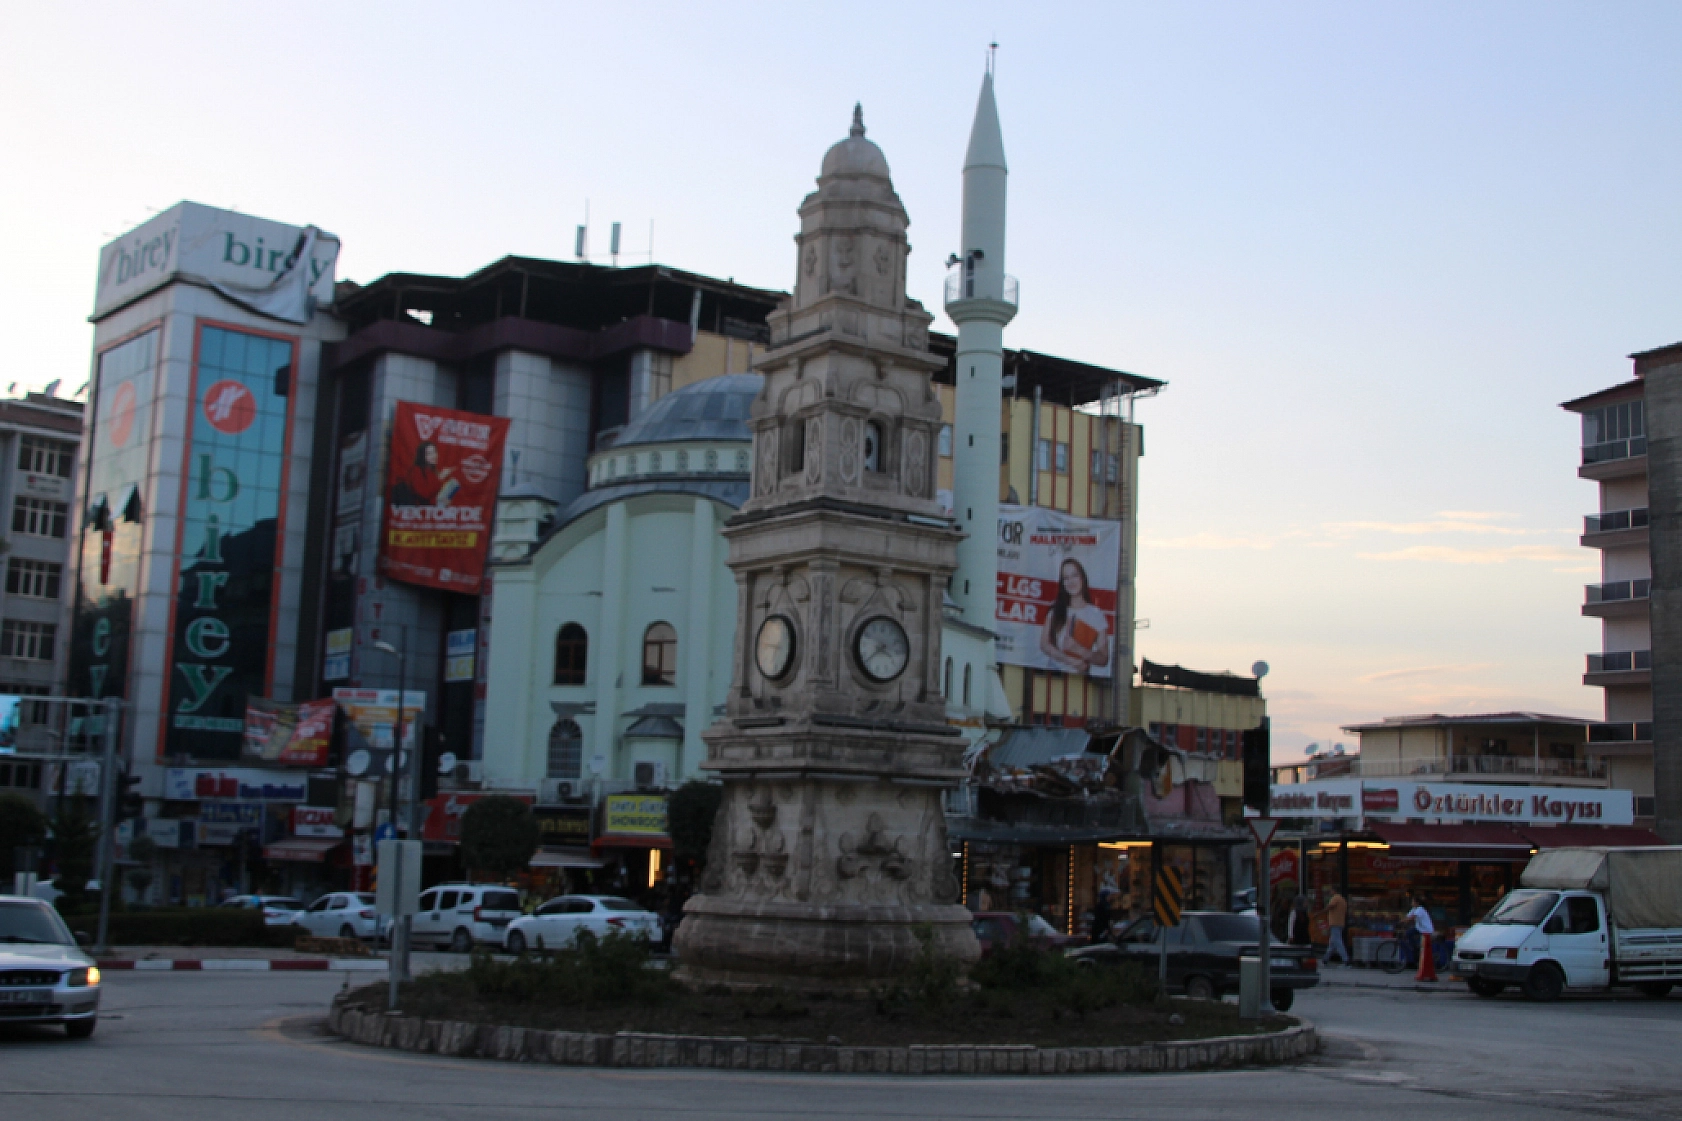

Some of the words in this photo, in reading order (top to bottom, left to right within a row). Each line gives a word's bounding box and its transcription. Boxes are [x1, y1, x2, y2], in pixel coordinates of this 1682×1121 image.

[176, 453, 239, 713] birey
[1007, 575, 1042, 598] LGS
[1414, 786, 1524, 815] Öztürkler
[1532, 795, 1603, 822] Kayısı
